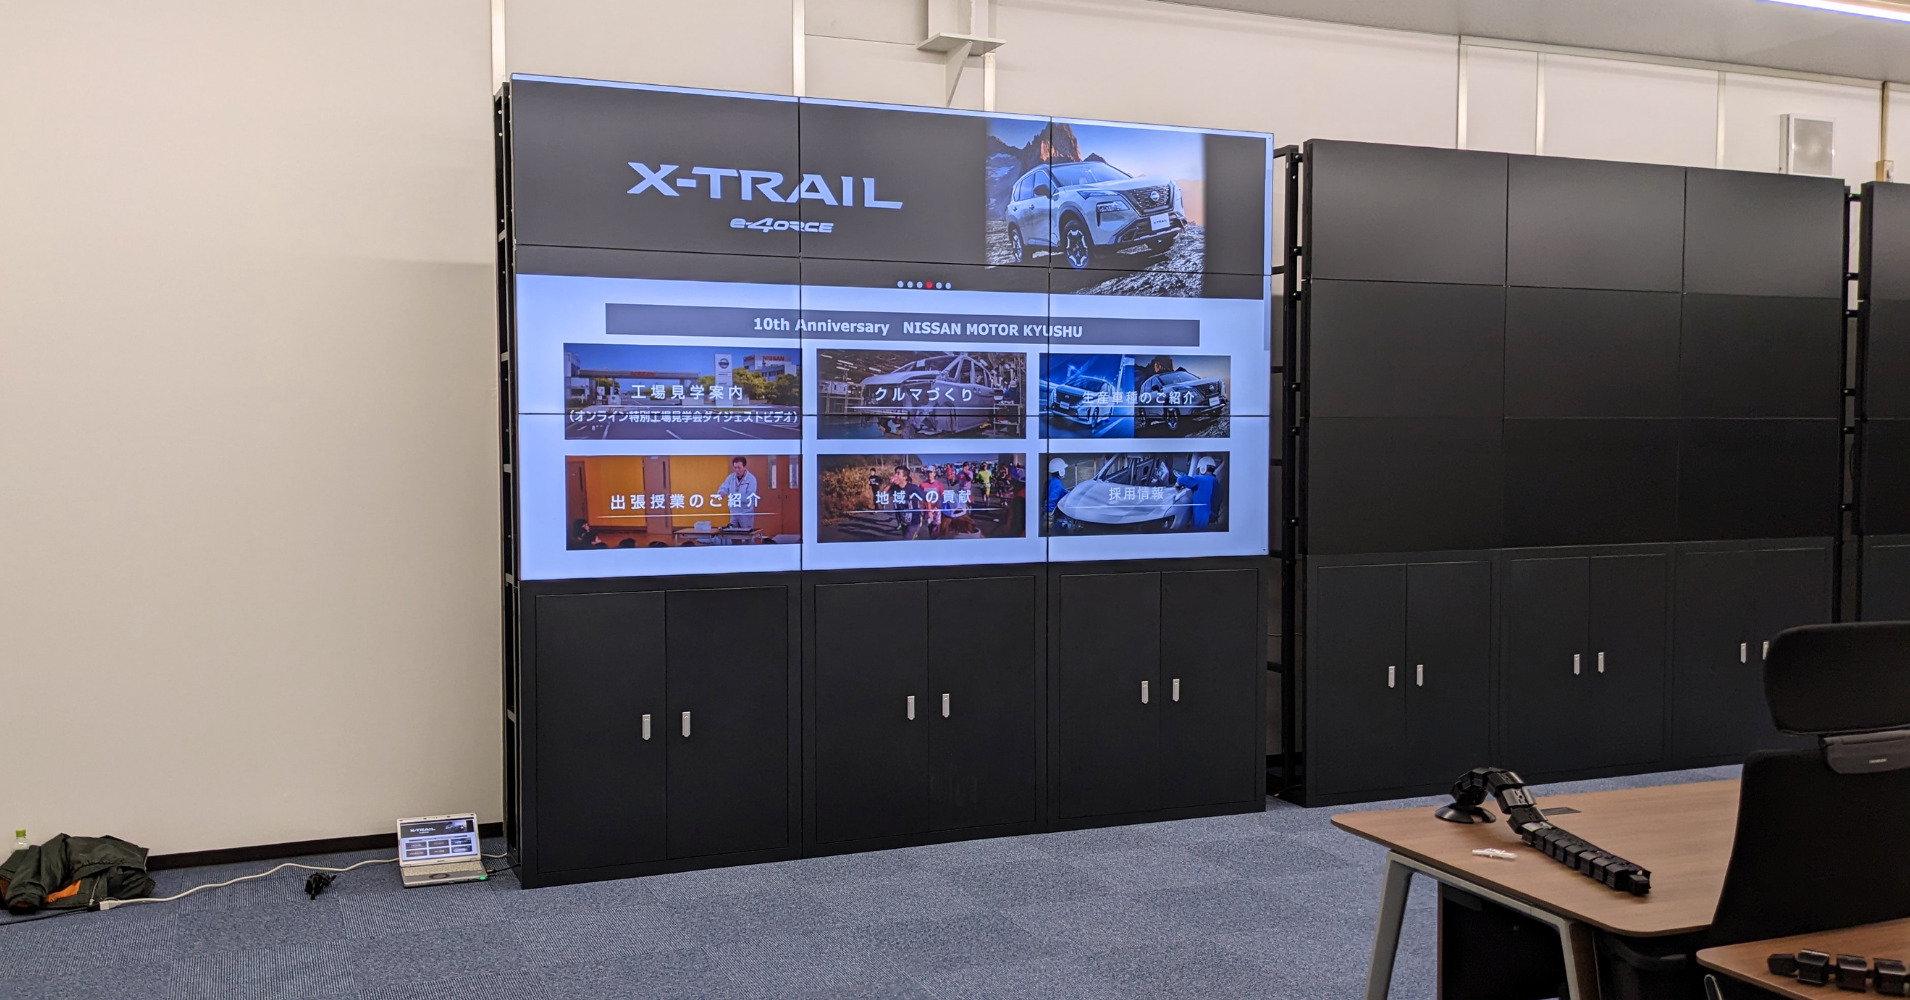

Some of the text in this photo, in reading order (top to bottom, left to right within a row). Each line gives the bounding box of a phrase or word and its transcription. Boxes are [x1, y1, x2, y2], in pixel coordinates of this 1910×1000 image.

[627, 161, 904, 210] X-TRAIL
[753, 317, 1083, 338] 10th Anniversary NISSAN MOTOR KYUSHU
[630, 384, 744, 401] 工場見学案内
[874, 386, 973, 402] クルマづくり
[1081, 390, 1196, 405] 生産車種のご紹介
[875, 489, 972, 505] 地域への貢献
[1108, 486, 1164, 501] 採用情報
[610, 493, 761, 511] 出張授業のご紹介
